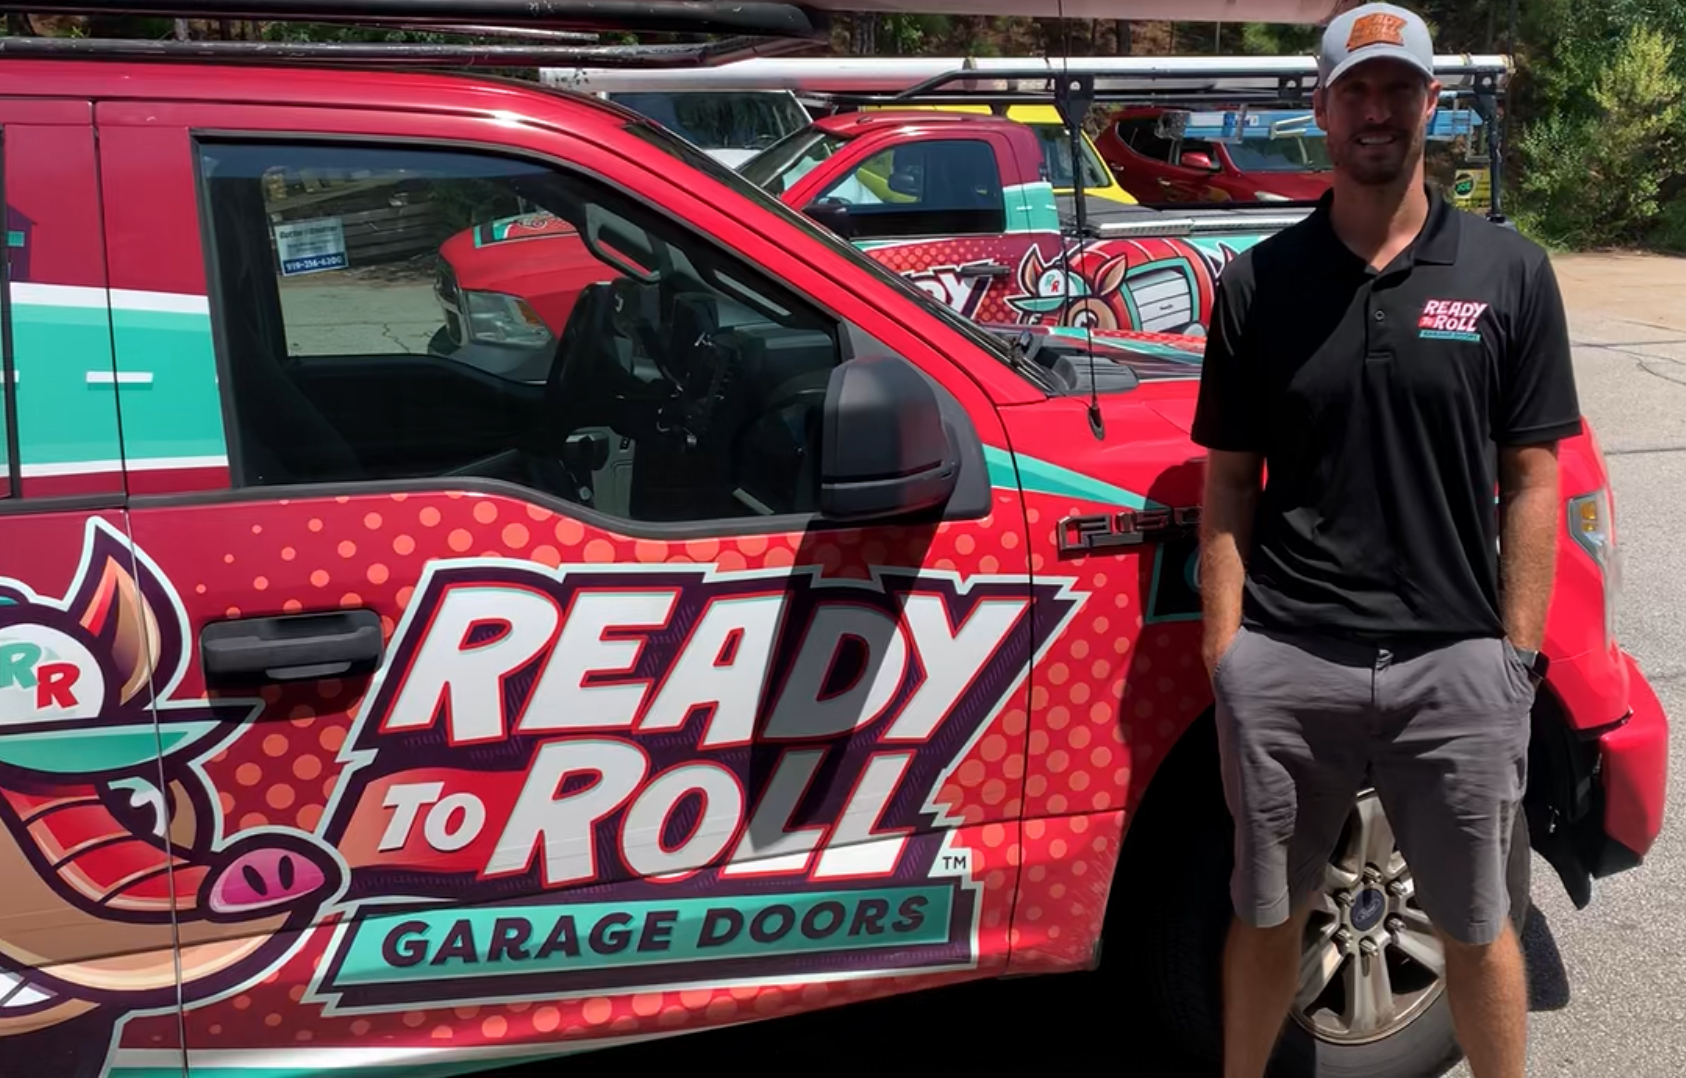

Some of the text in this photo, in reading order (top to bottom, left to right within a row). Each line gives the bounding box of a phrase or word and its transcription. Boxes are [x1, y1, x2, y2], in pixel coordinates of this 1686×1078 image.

[1423, 300, 1488, 318] READY
[1433, 315, 1477, 332] ROLL
[382, 584, 1030, 746] READY
[480, 737, 916, 886] ROLL
[382, 896, 929, 968] GARAGE DOORS
